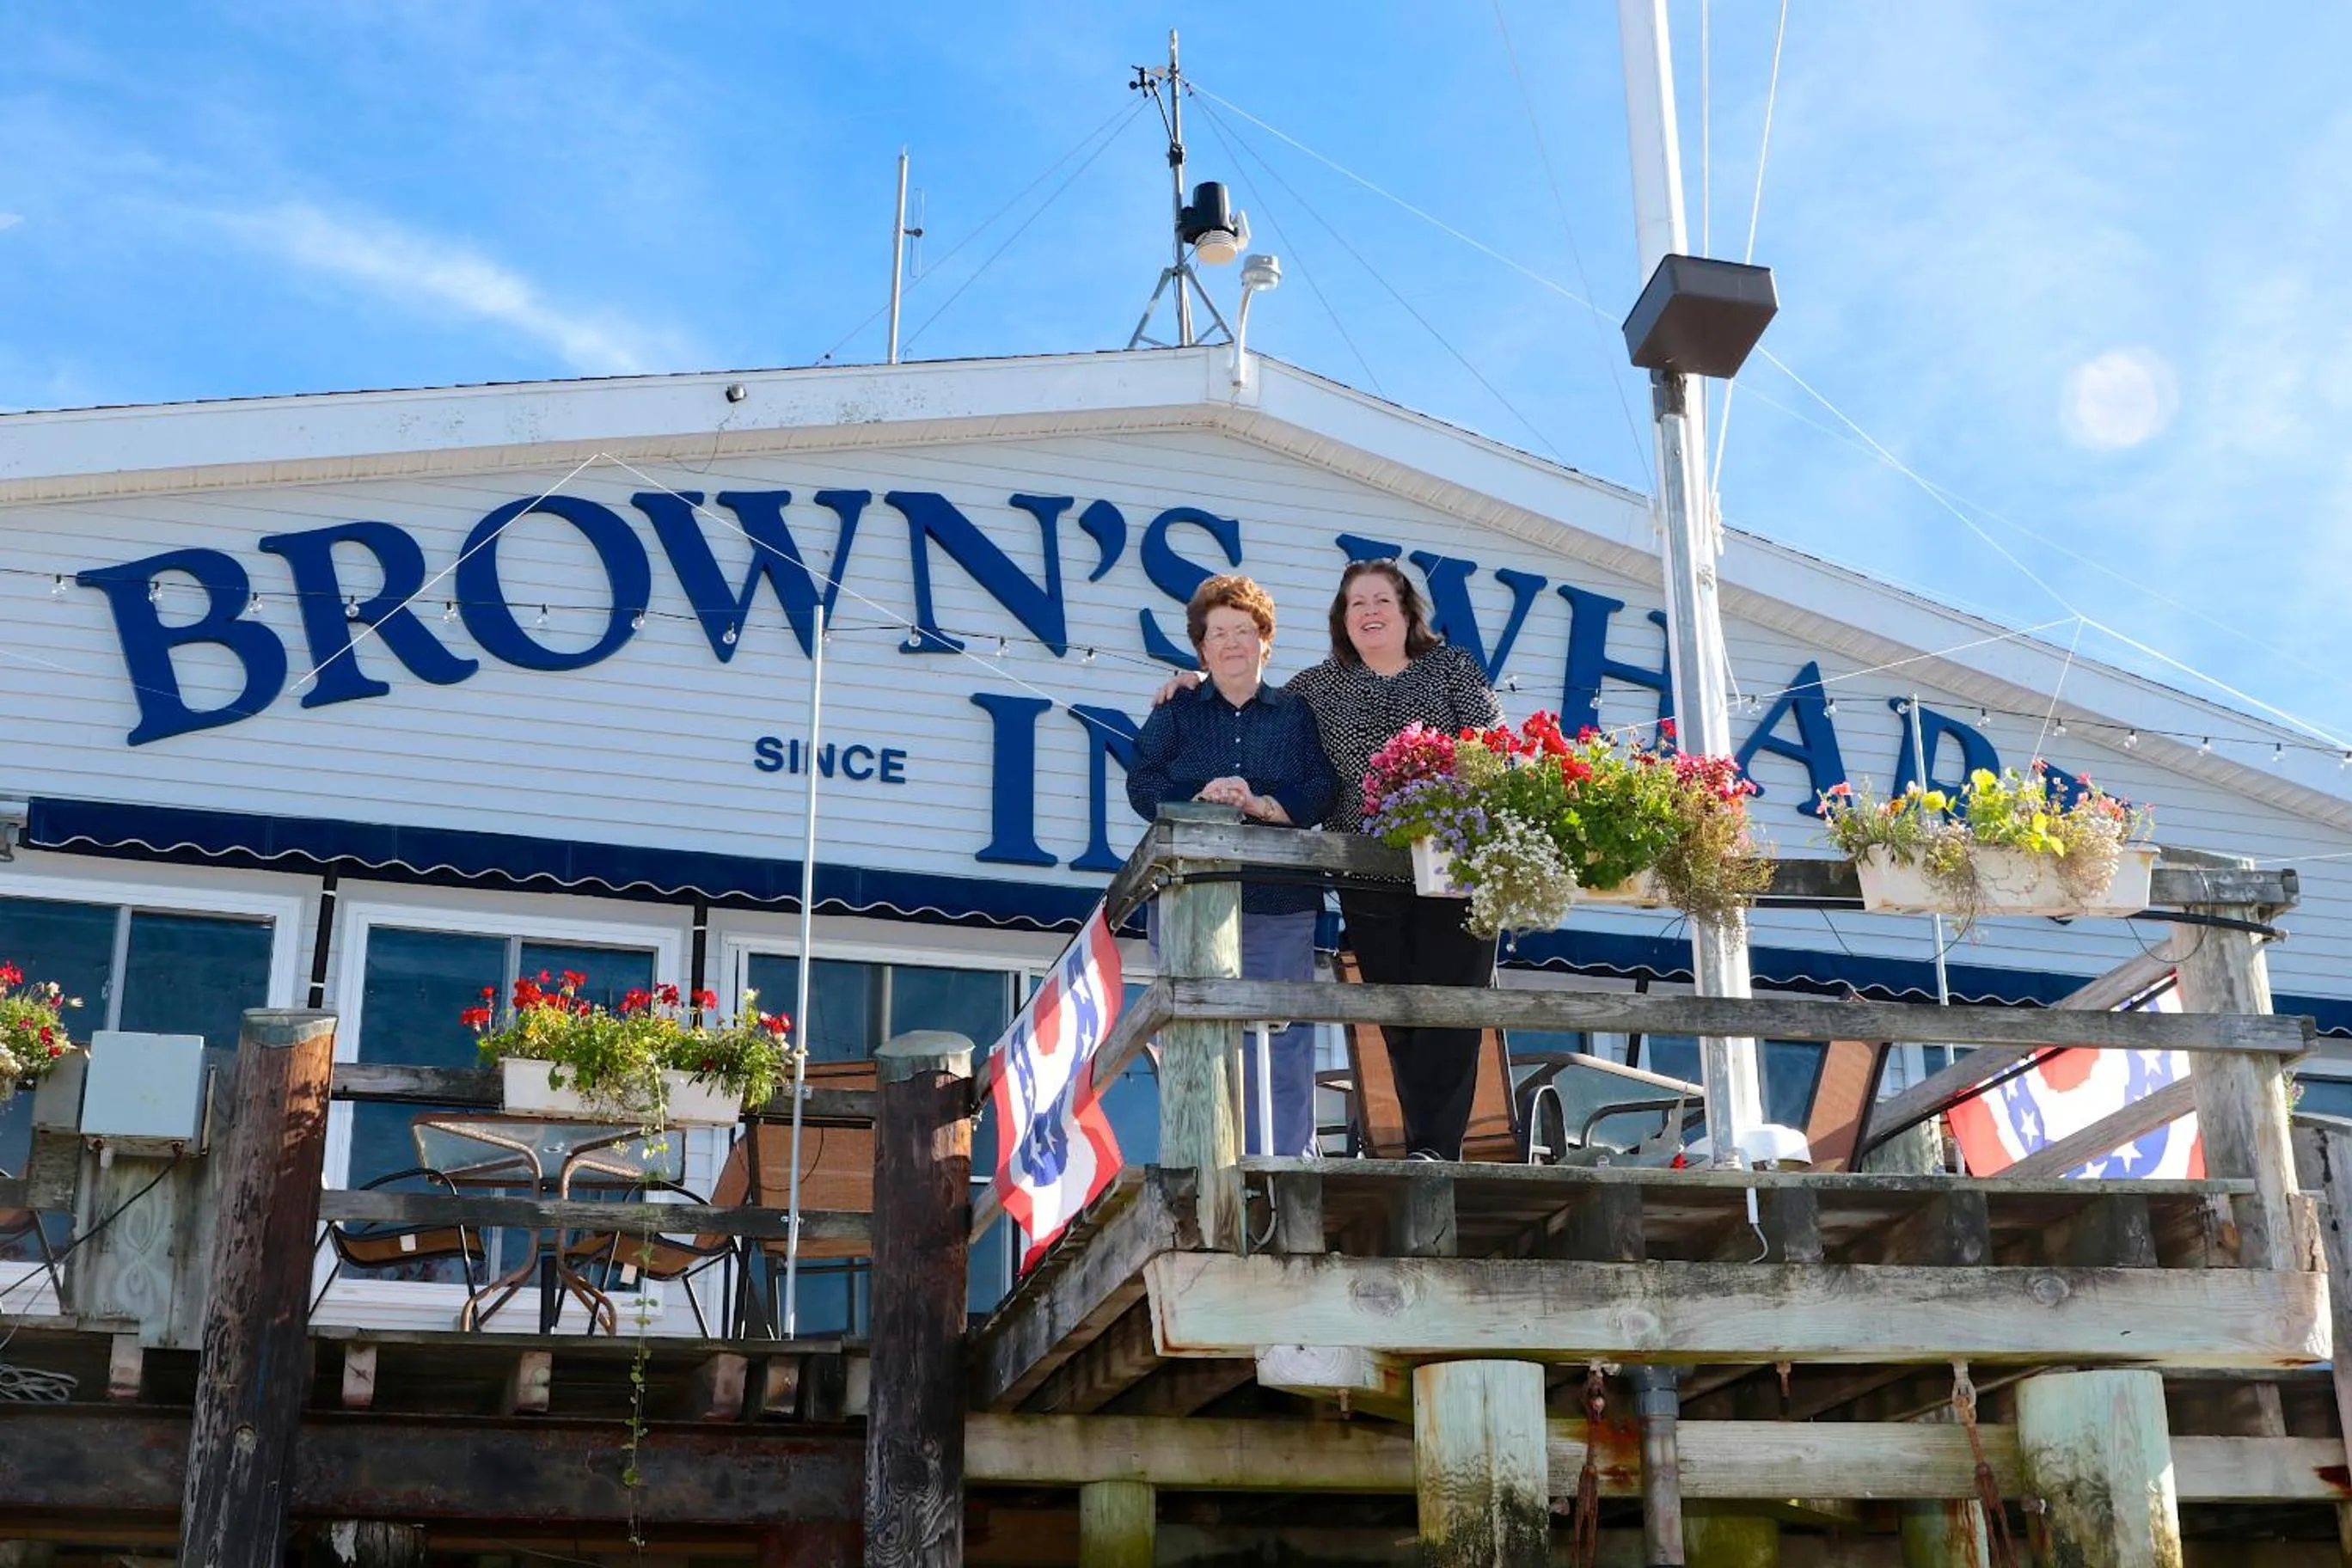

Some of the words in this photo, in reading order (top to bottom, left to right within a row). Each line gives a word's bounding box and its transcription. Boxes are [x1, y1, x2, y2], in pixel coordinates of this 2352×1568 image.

[76, 489, 1242, 747] BROWN'S
[1335, 533, 2133, 825] WHAR
[753, 736, 908, 785] SINCE
